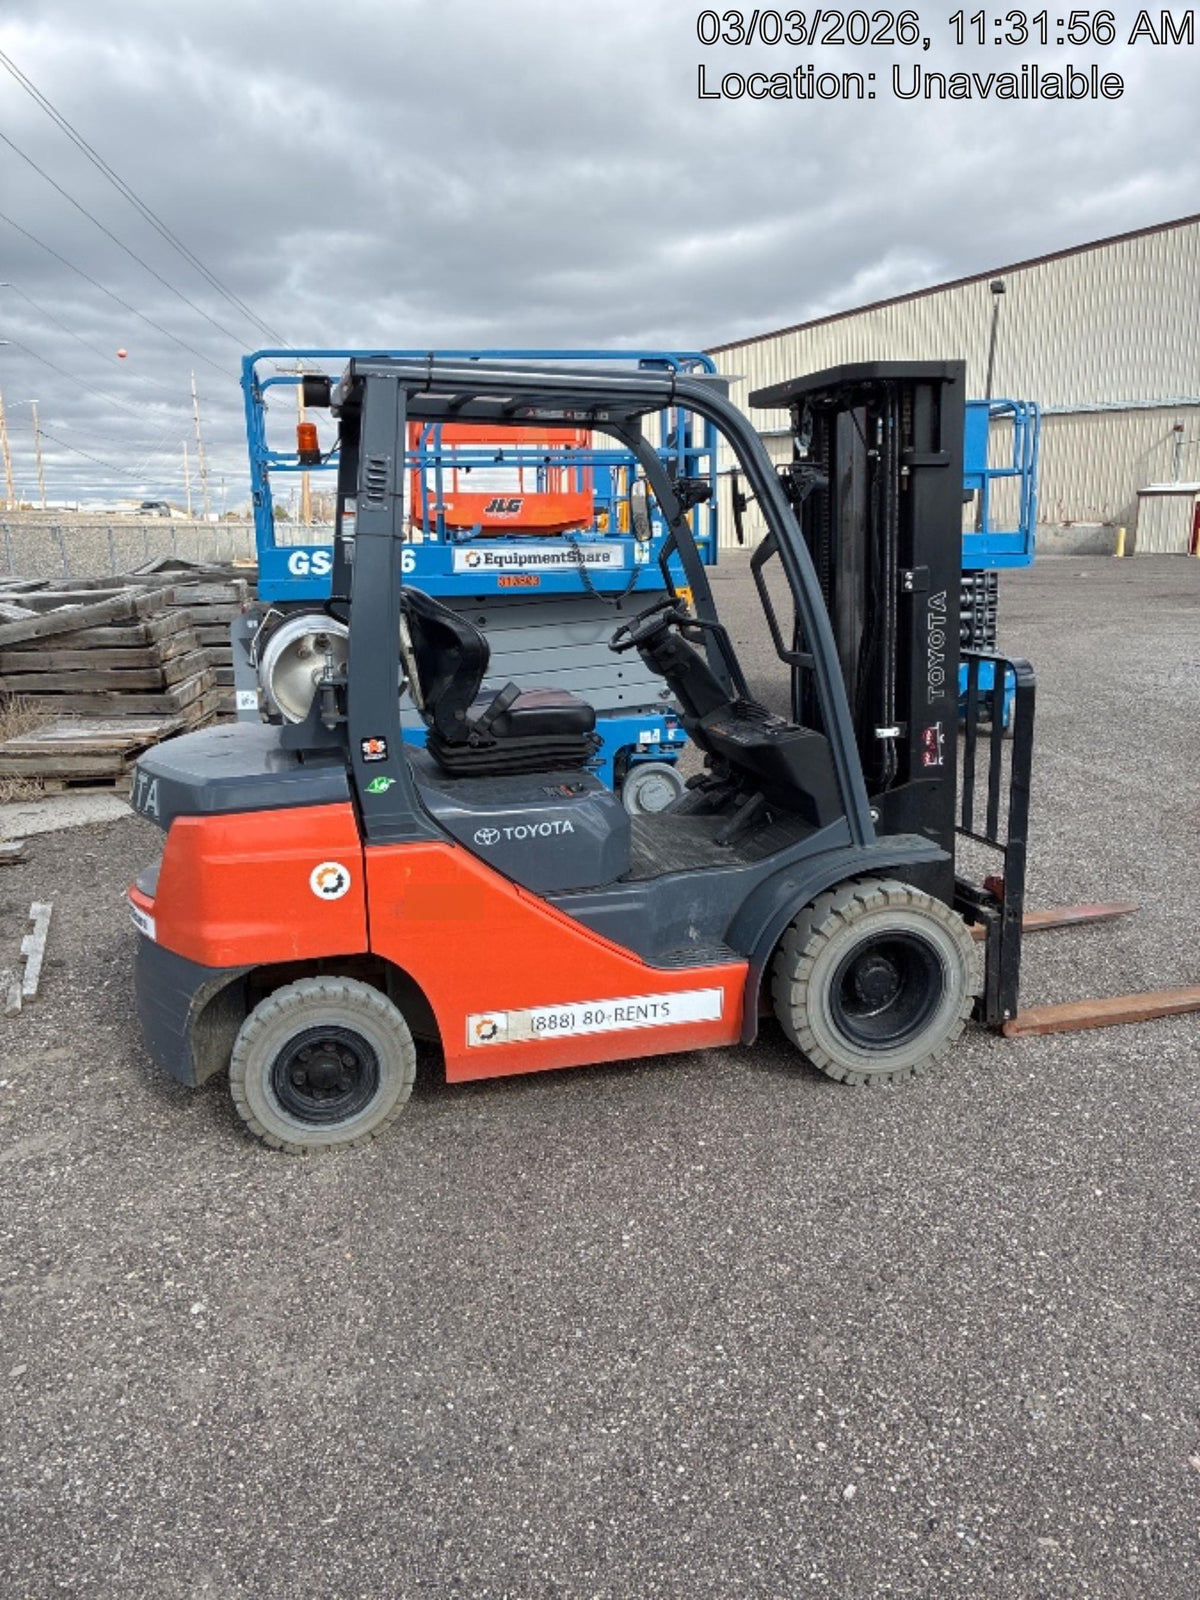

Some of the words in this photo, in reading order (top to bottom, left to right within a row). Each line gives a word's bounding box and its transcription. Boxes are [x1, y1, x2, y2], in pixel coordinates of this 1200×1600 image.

[484, 498, 524, 512] JLG
[927, 590, 947, 704] TOYOTA
[503, 820, 575, 841] TOYOTA
[530, 1012, 576, 1033] (888)
